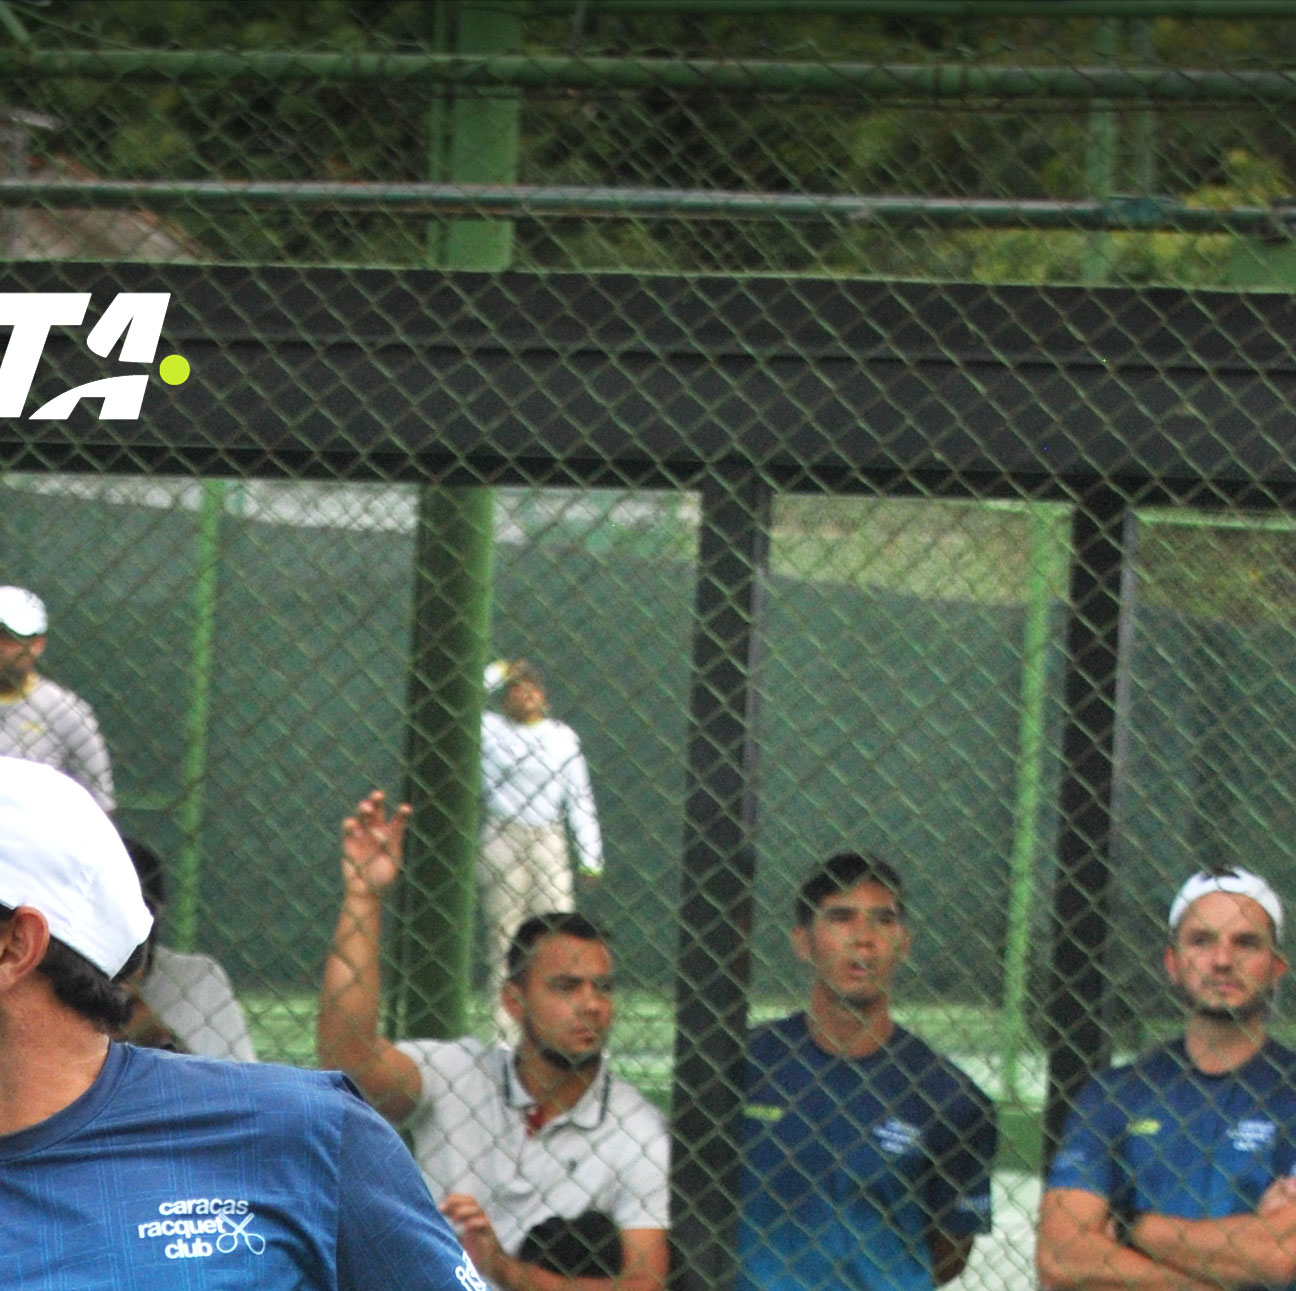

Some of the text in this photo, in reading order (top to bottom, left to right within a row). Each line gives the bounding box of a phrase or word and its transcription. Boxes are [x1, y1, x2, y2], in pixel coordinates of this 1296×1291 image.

[158, 1198, 249, 1215] caracas
[138, 1216, 226, 1239] racquet
[164, 1237, 213, 1260] club
